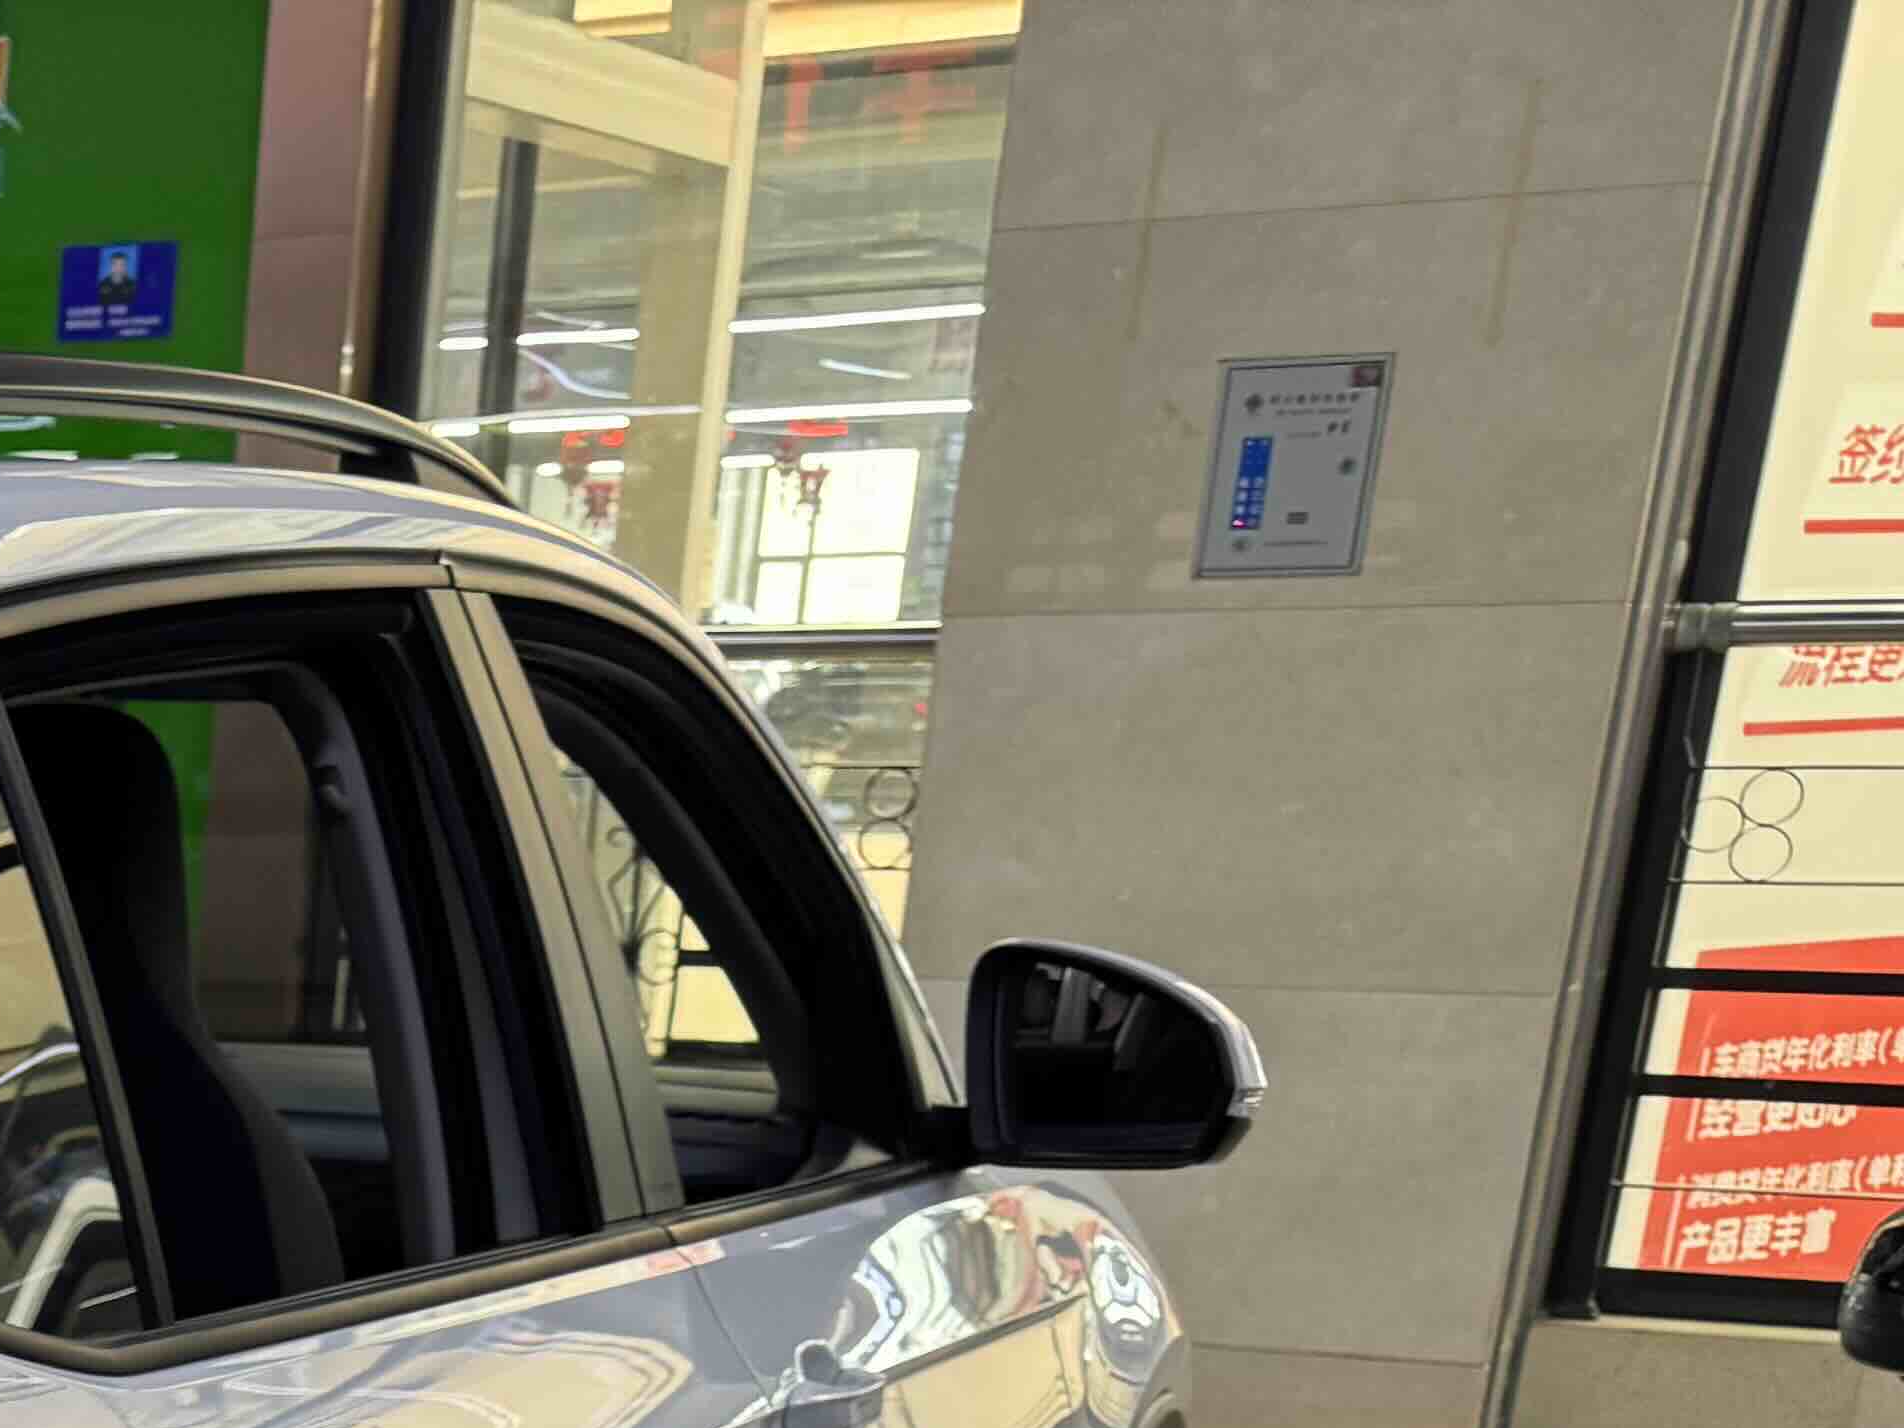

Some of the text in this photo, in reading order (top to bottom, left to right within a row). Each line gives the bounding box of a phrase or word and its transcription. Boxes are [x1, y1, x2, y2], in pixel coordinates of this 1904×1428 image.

[1673, 1207, 1837, 1270] 产品更丰富
